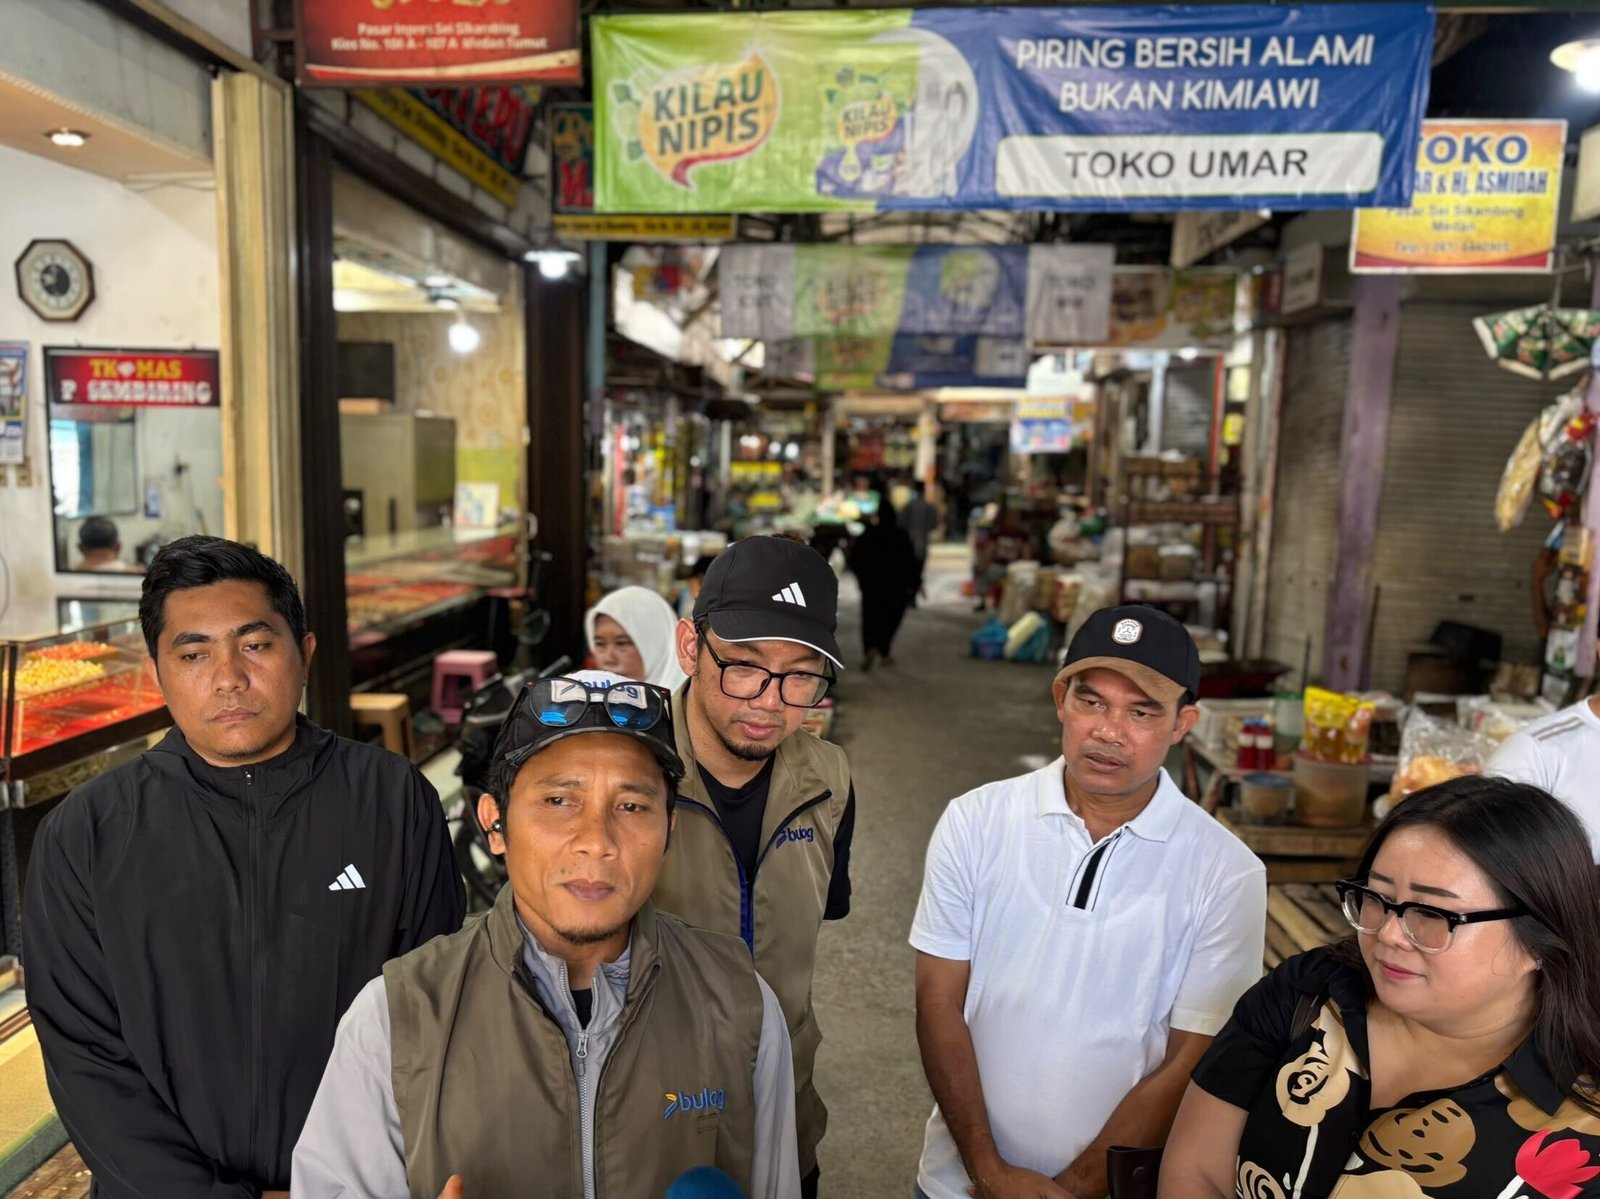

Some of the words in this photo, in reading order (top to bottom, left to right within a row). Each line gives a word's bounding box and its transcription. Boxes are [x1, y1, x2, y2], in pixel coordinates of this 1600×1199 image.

[357, 22, 393, 36] Pasar
[1016, 38, 1126, 70] PIRING
[1134, 36, 1251, 69] BERSIH
[1259, 34, 1376, 68] ALAMI
[653, 69, 764, 121] KILAU
[1059, 80, 1174, 112] BUKAN
[1181, 78, 1320, 110] KIMIAWI
[658, 108, 761, 156] NIPIS
[1065, 151, 1174, 179] TOKO
[1190, 149, 1309, 178] UMAR
[1419, 135, 1528, 165] OKO
[1475, 171, 1549, 194] ASMIDAH
[136, 359, 182, 380] MAS
[87, 380, 212, 404] SEMBIRING
[679, 1087, 726, 1112] bulog
